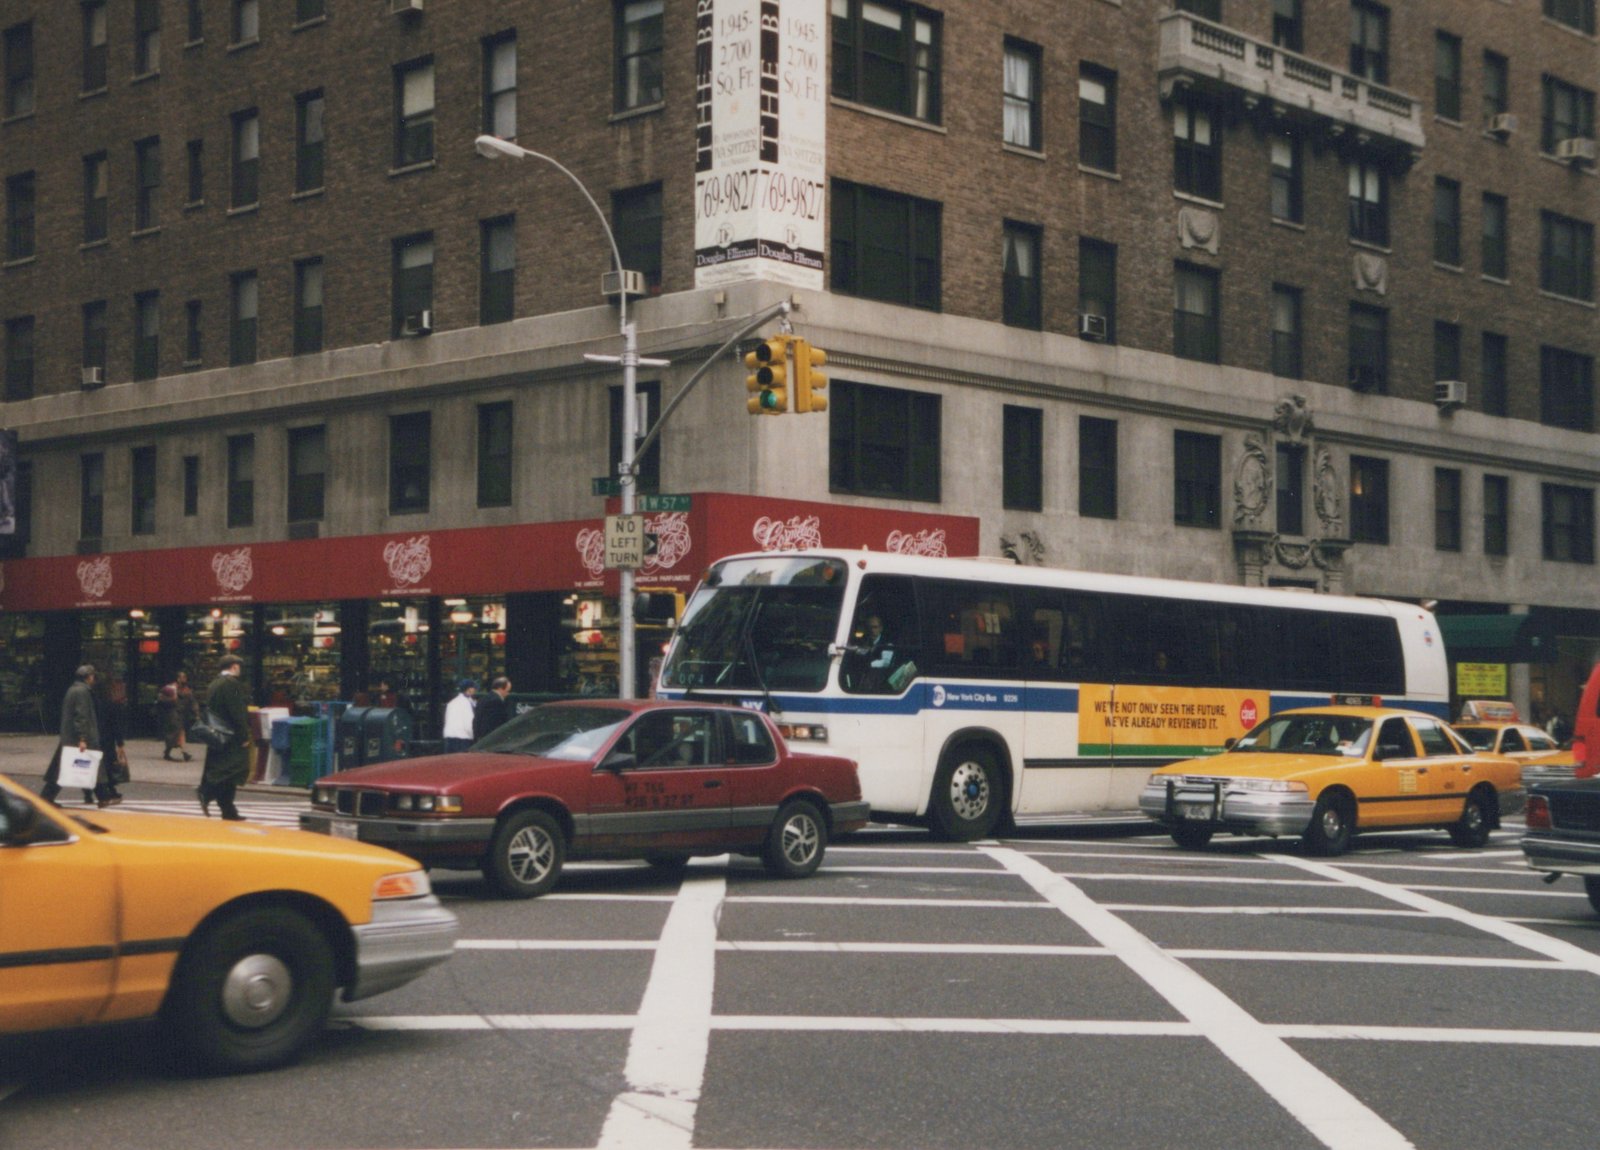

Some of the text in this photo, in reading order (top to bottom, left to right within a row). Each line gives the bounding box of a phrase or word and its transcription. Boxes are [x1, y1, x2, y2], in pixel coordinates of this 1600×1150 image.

[761, 59, 779, 150] THE
[697, 70, 712, 162] THE
[697, 247, 757, 266] Douglas Elliman
[760, 244, 822, 268] Douglas Elliman
[649, 498, 658, 509] W
[662, 497, 676, 510] 57
[616, 521, 636, 533] NO
[611, 537, 637, 549] LEFT
[610, 552, 638, 563] TURN
[946, 693, 960, 701] New
[960, 693, 974, 702] York
[974, 693, 985, 703] City
[985, 694, 997, 702] Bus
[1094, 700, 1227, 717] WE'VE NOT ONLY SEEN THE FUTURE,
[1104, 716, 1219, 730] WE'VE ALREADY REVIEWED IT.
